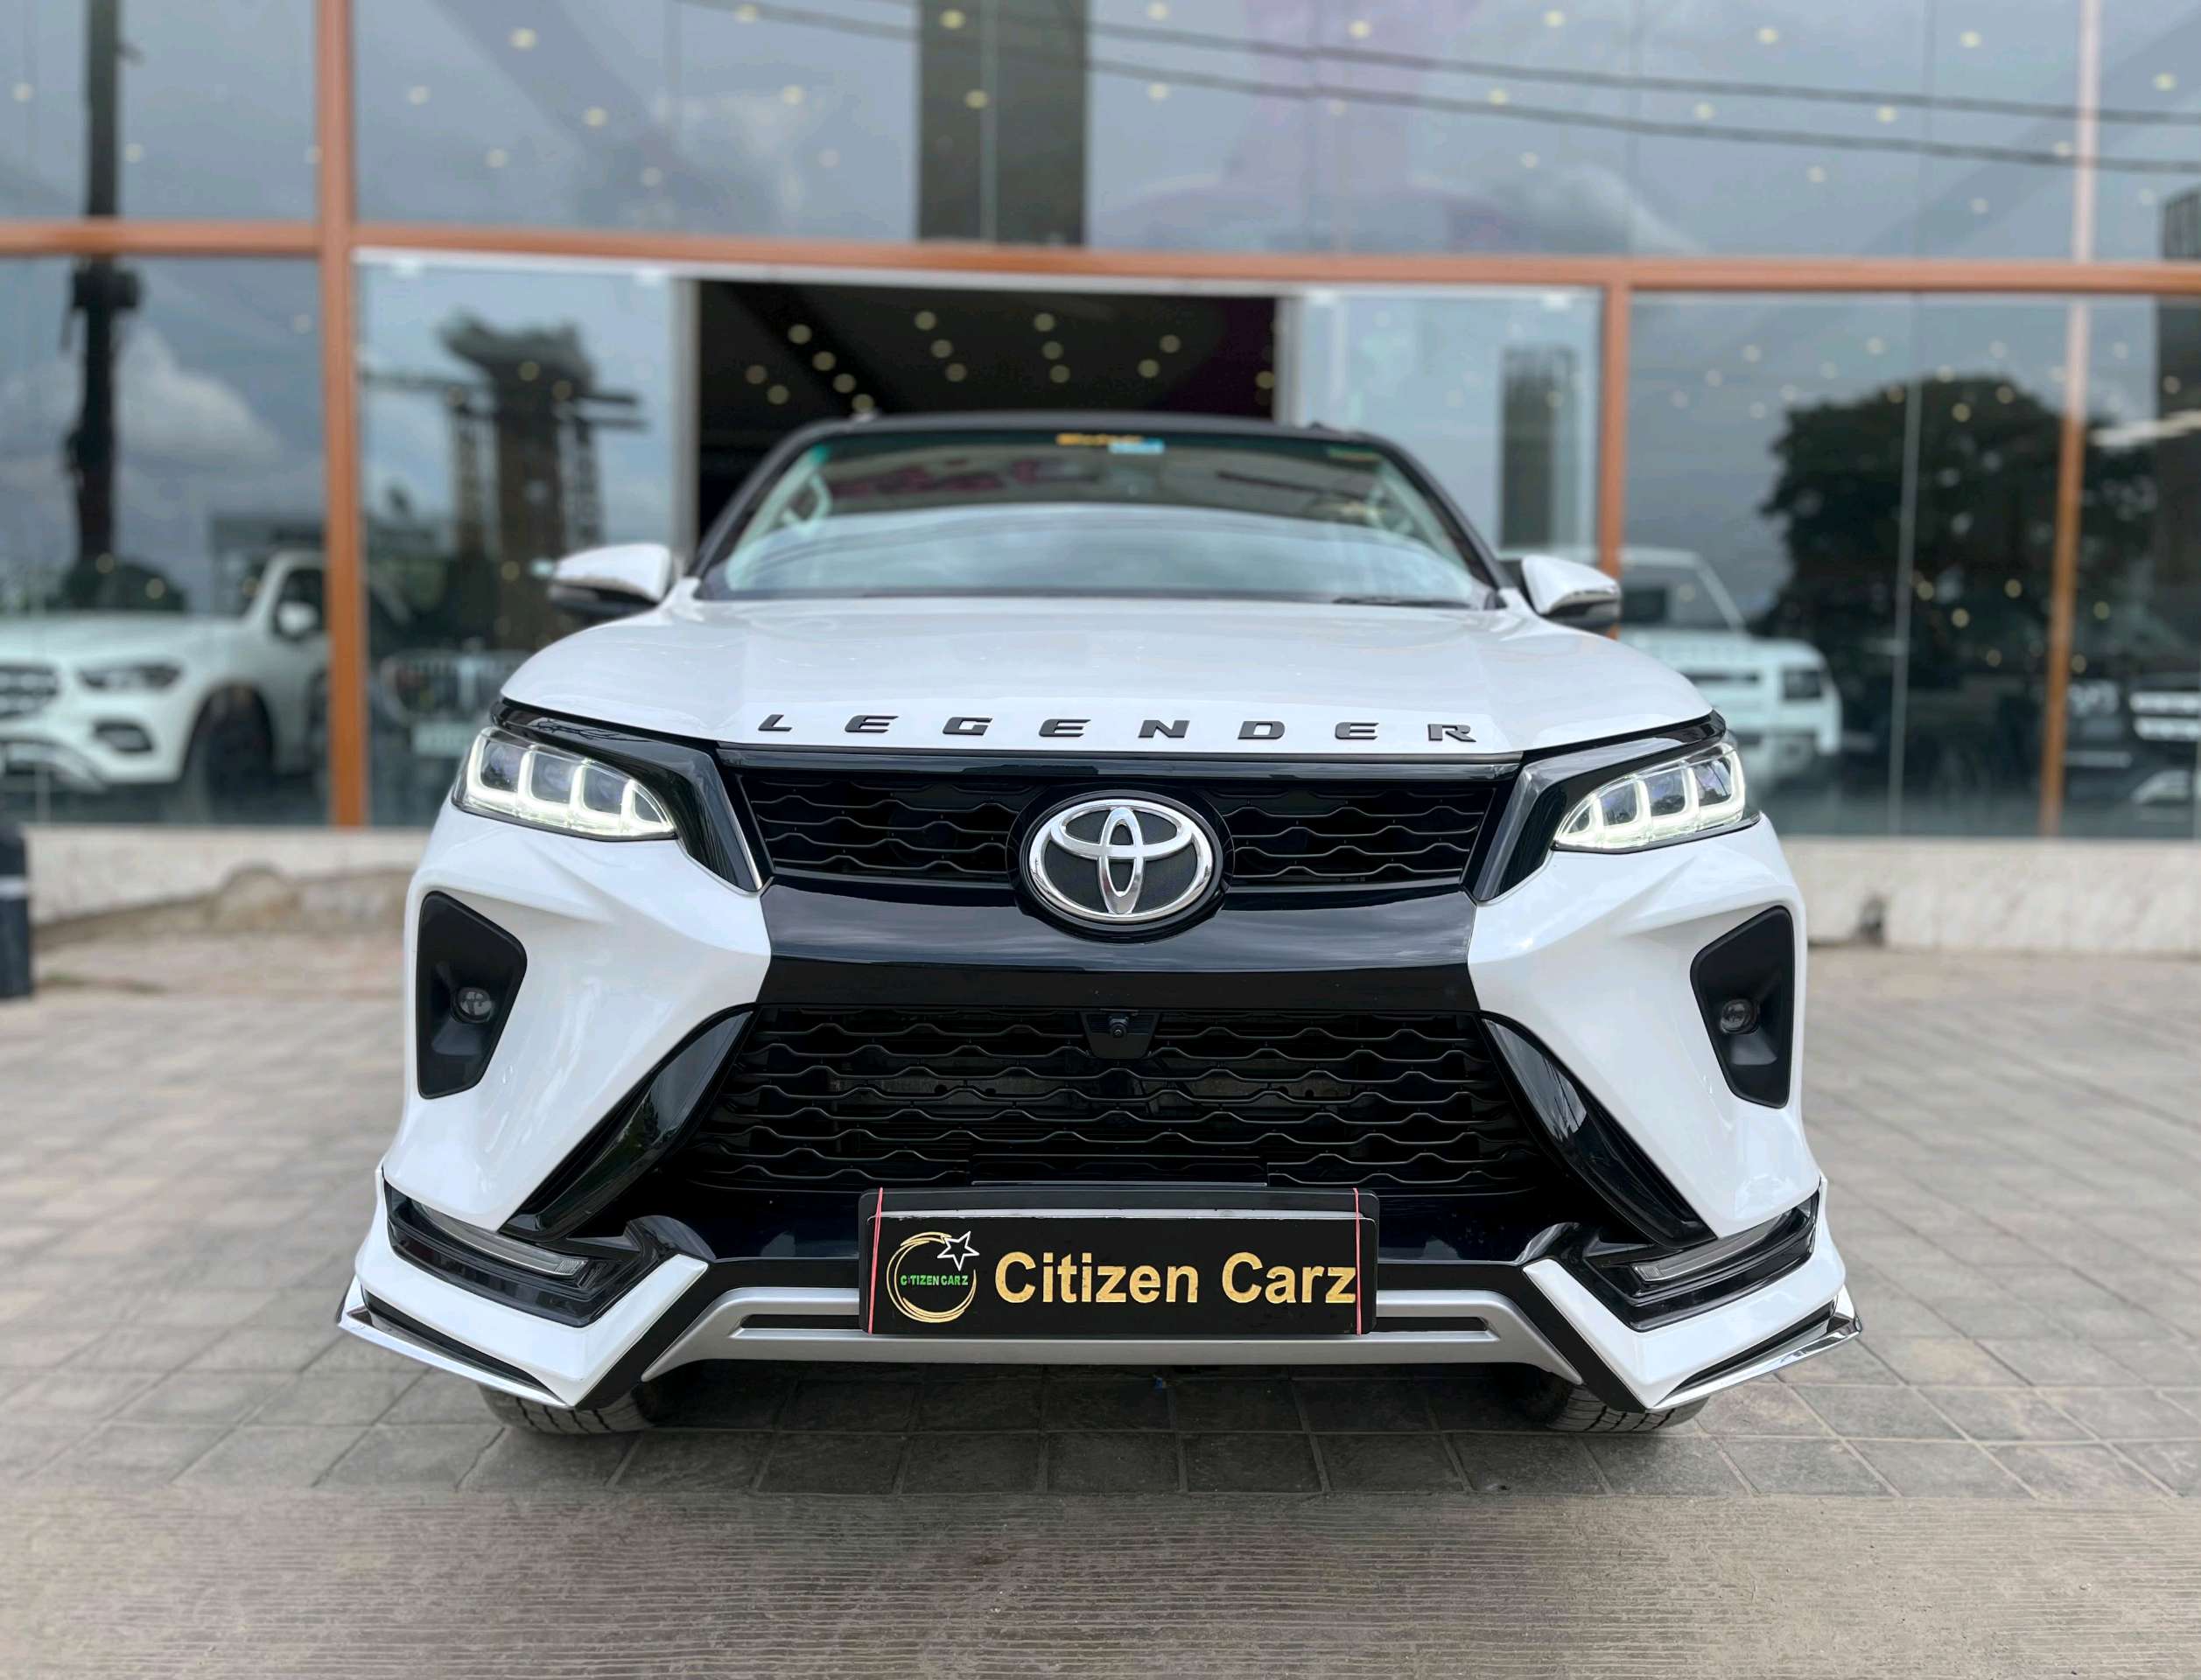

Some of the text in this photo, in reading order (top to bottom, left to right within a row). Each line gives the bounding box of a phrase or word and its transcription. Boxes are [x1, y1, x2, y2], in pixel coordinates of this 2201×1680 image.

[758, 713, 1476, 742] LEGENDER
[994, 1251, 1356, 1304] Citizen Carz
